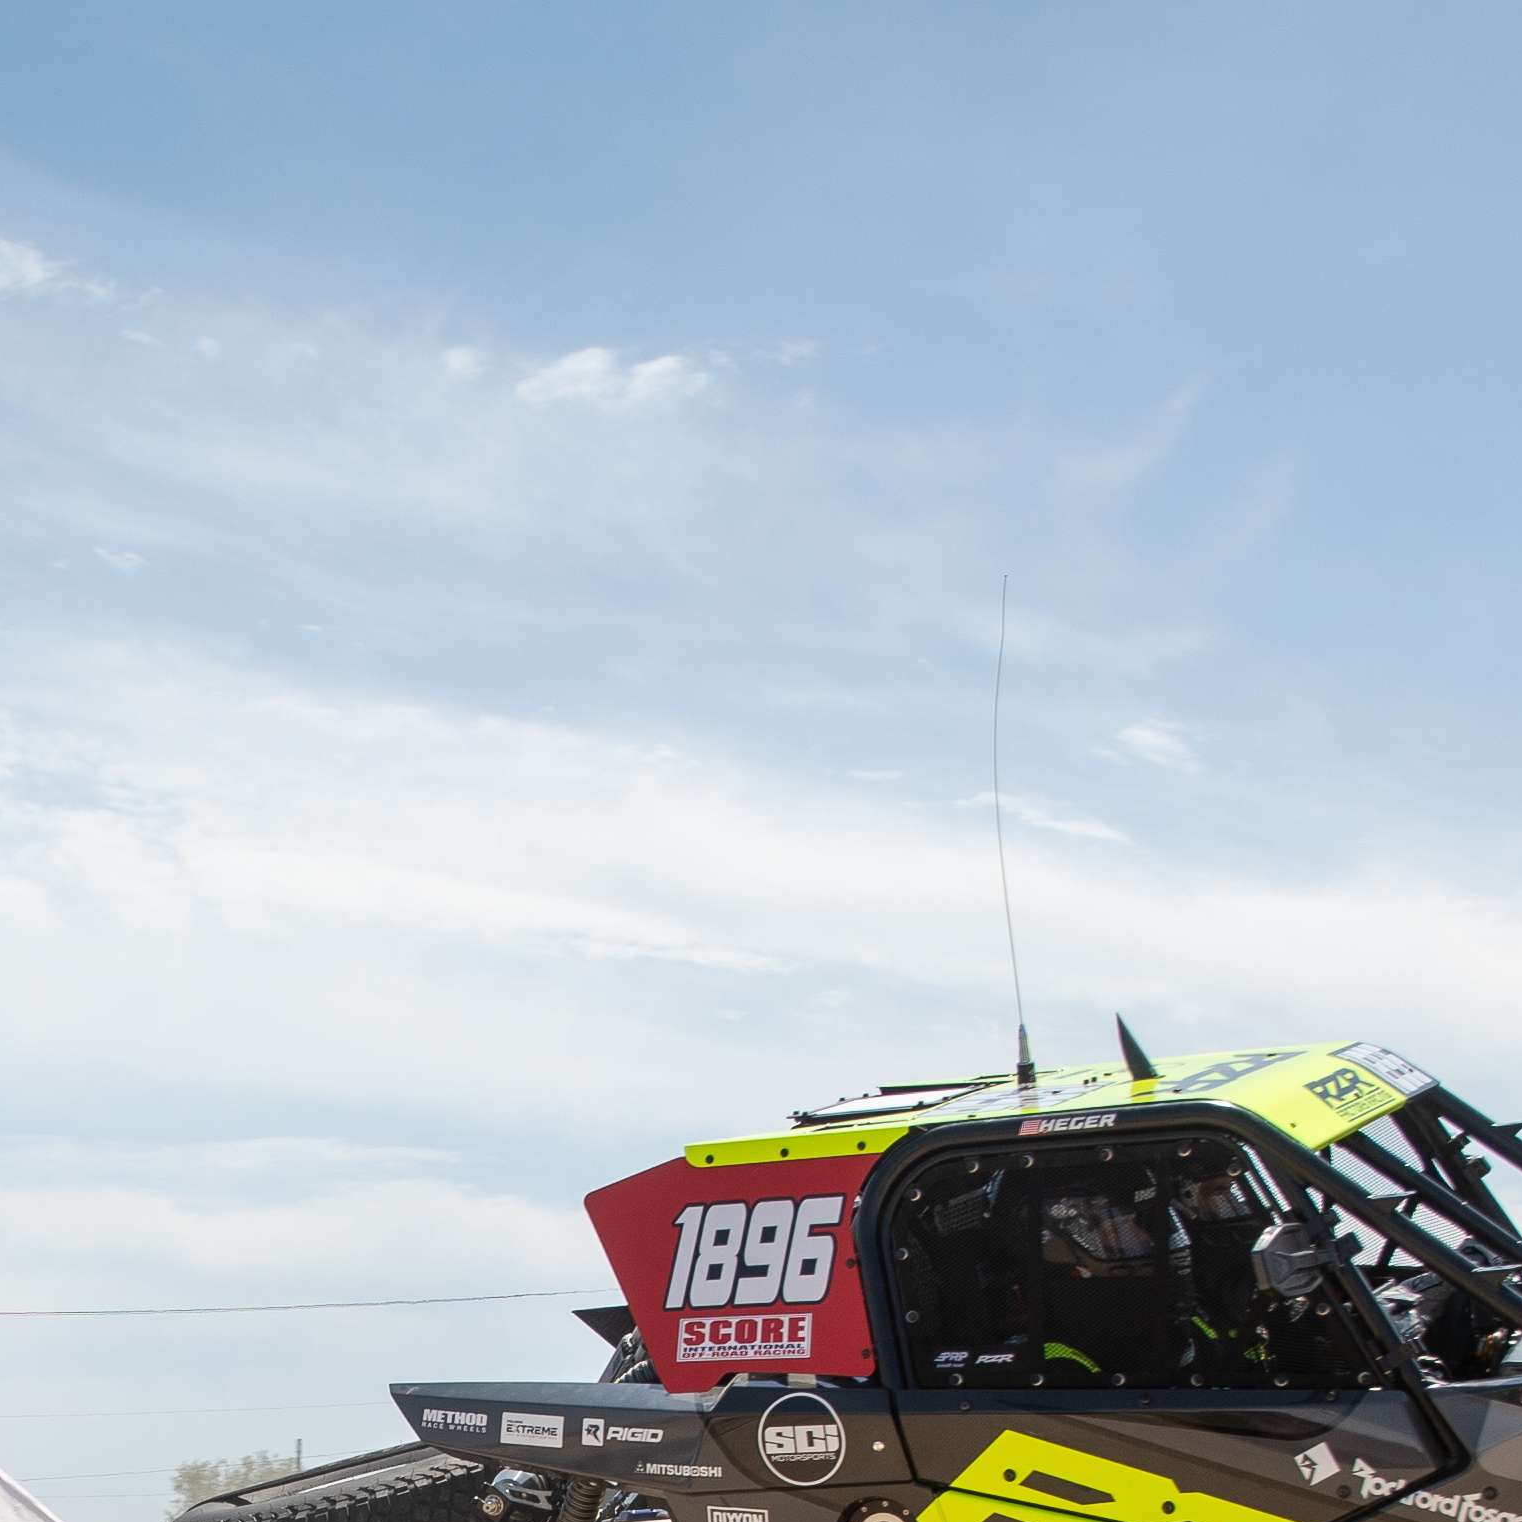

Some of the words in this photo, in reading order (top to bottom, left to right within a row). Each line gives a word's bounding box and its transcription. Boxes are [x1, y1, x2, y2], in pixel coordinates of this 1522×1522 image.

[1039, 1113, 1117, 1132] HEGER
[664, 1195, 845, 1309] 1896
[682, 1316, 807, 1346] SCORE
[683, 1343, 805, 1353] INTERNATIONAL
[753, 1348, 806, 1356] RACING
[422, 1408, 488, 1427] METHOD
[421, 1421, 445, 1431] RACE
[448, 1424, 487, 1434] WHEELS
[506, 1423, 559, 1437] EXTREME
[606, 1426, 664, 1443] RIGID
[771, 1452, 837, 1462] MOTORSPORTS
[645, 1463, 723, 1478] MITSUBOSHI
